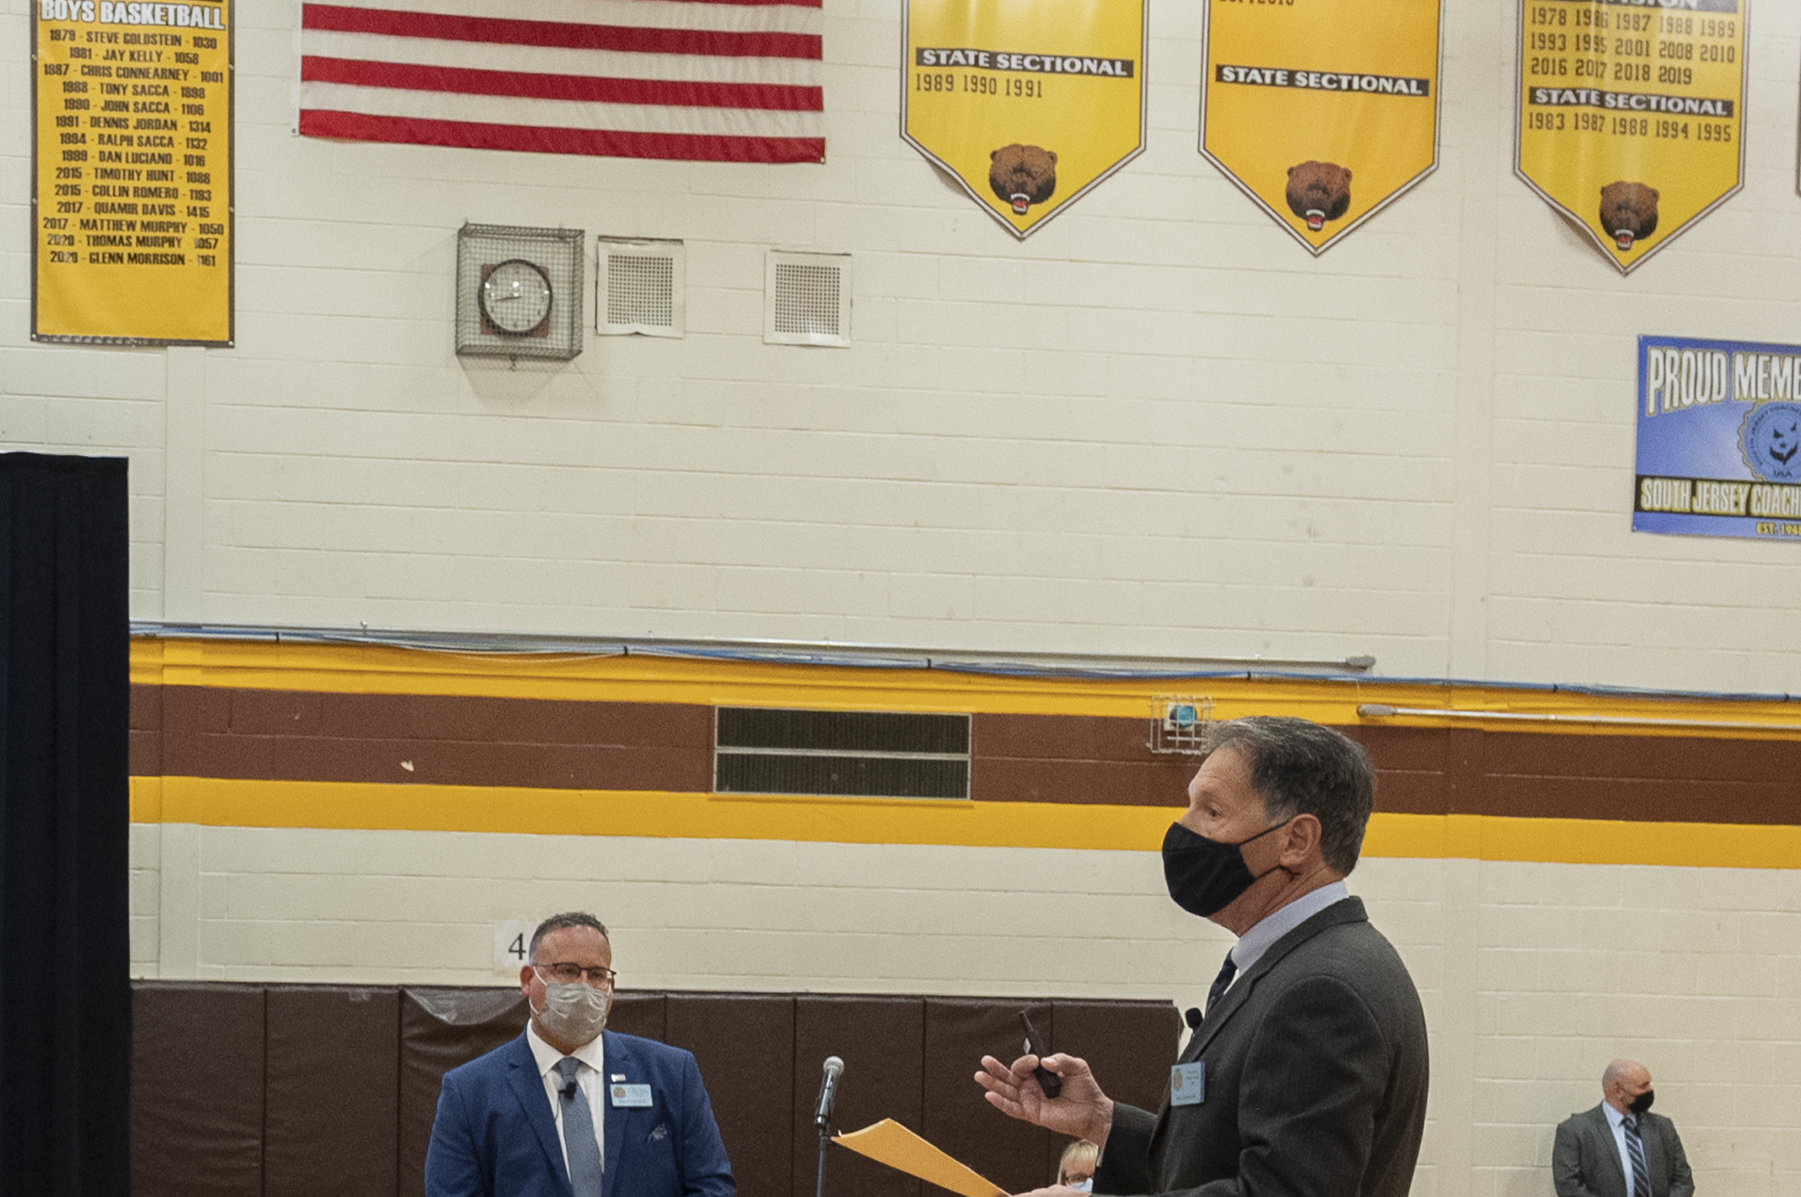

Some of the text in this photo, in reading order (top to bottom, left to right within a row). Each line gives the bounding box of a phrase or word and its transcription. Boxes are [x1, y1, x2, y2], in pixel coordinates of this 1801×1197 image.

[40, 0, 226, 30] BOYS BASKETBALL
[1531, 7, 1567, 26] 1978
[1615, 13, 1651, 33] 1987
[86, 31, 120, 44] STEVE
[1531, 32, 1567, 52] 1993
[1614, 38, 1651, 57] 2001
[1658, 41, 1693, 60] 2008
[1700, 44, 1736, 63] 2010
[103, 49, 126, 62] JAY
[922, 48, 1128, 76] STATE SECTIONAL
[81, 64, 112, 78] CHRIS
[1531, 57, 1693, 85] 2016 2017 2018 2019
[915, 73, 1042, 99] 1989 1990 1991
[1222, 65, 1423, 96] STATE SECTIONAL
[100, 82, 128, 96] TONY
[101, 100, 129, 114] JOHN
[1535, 89, 1727, 115] STATE SECTIONAL
[90, 117, 129, 130] DENNIS
[1655, 119, 1689, 140] 1994
[1697, 123, 1732, 142] 1995
[98, 133, 133, 147] RALPH
[99, 151, 122, 164] DAN
[94, 168, 143, 182] TIMOTHY
[92, 184, 130, 198] COLLIN
[94, 202, 138, 215] QUAMIR
[79, 219, 137, 233] MATTHEW
[86, 234, 132, 248] THOMAS
[89, 252, 124, 265] GLENN
[1647, 346, 1729, 418] PROUD
[1641, 478, 1692, 512] SOUTH
[1692, 481, 1750, 515] JERSEY
[508, 932, 527, 960] 4
